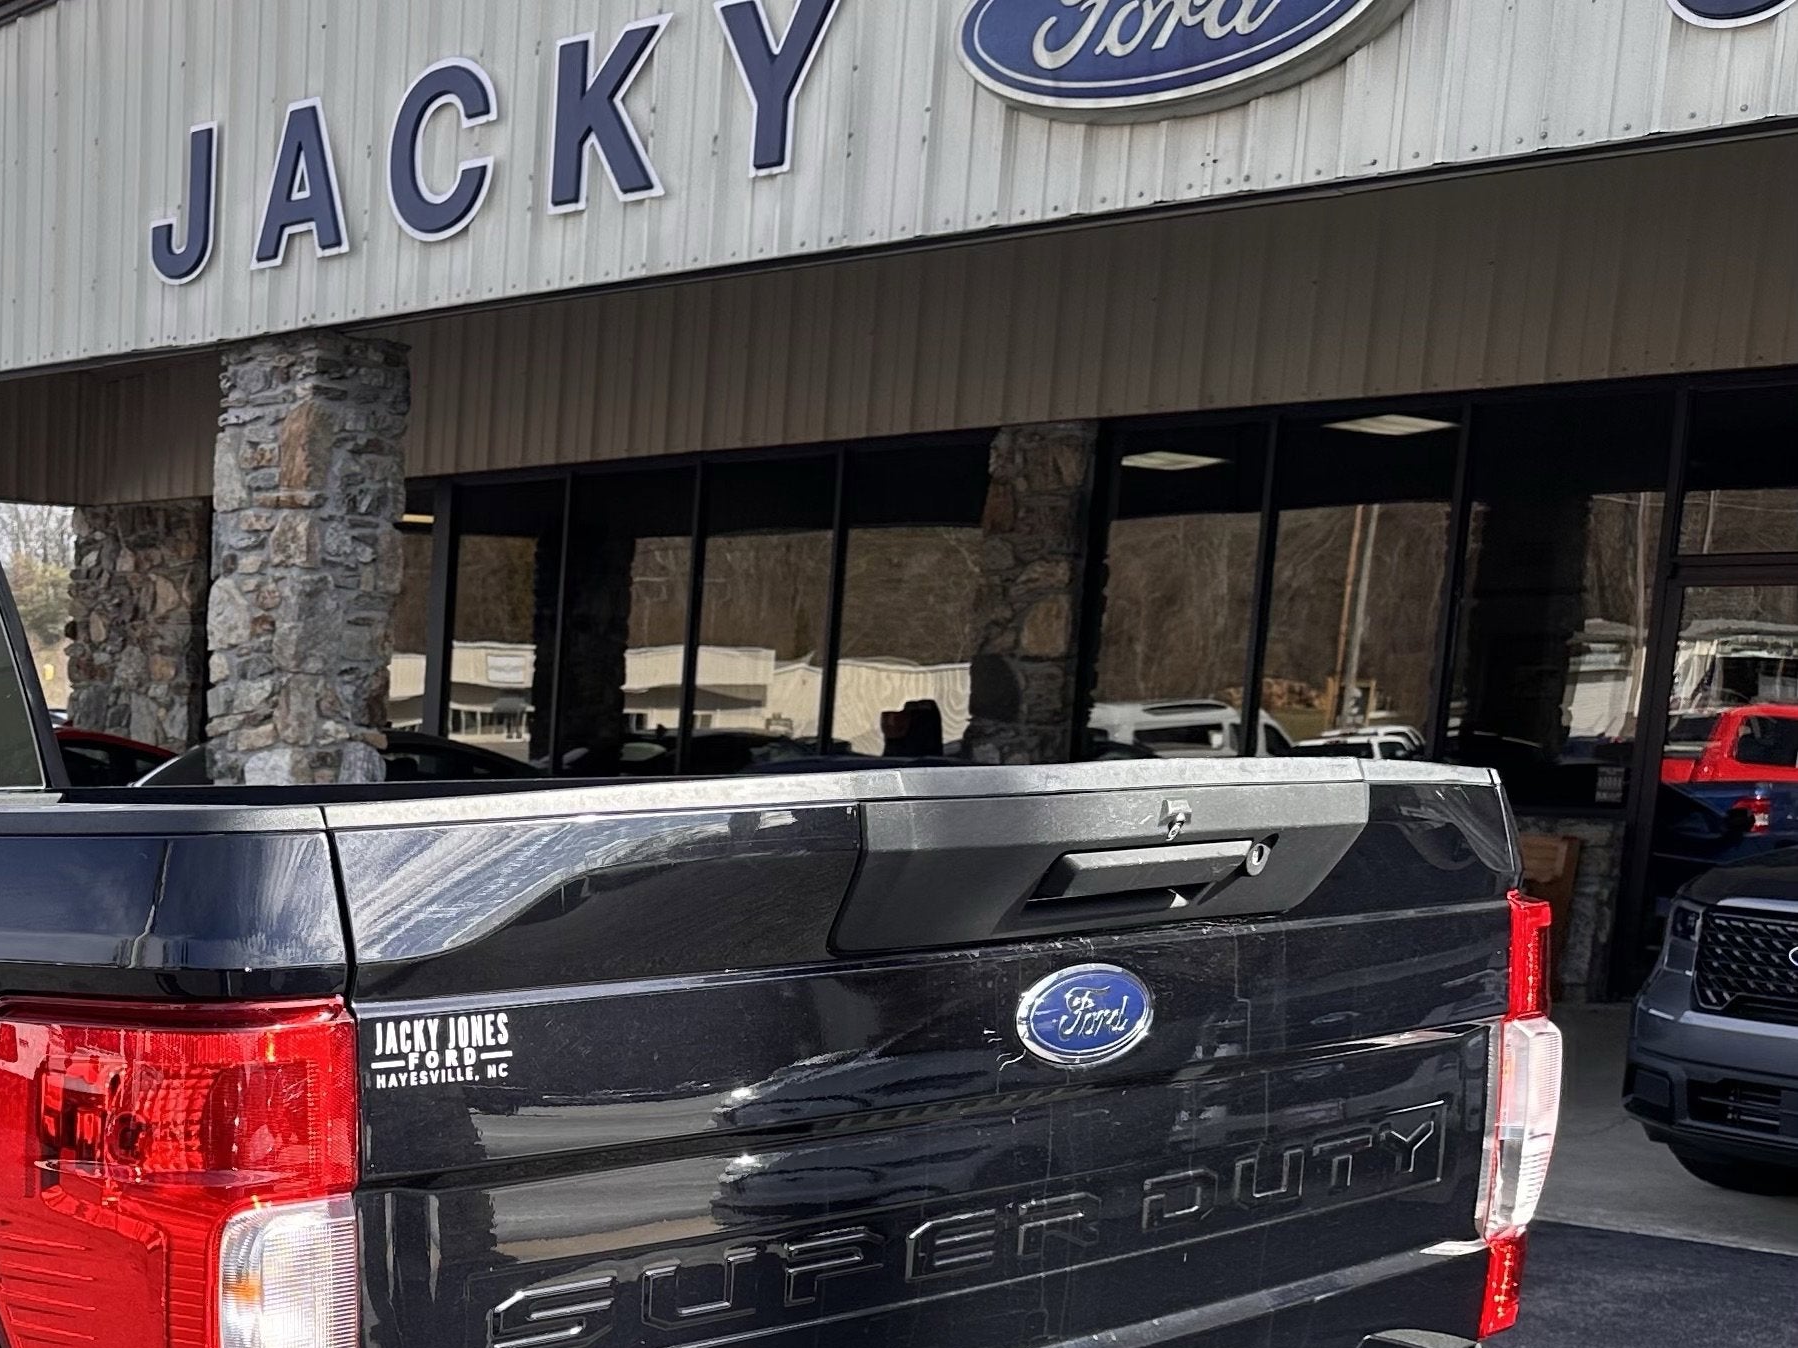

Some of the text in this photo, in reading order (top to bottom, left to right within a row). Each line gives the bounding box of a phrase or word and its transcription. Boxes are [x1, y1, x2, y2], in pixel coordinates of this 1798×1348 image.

[151, 0, 840, 286] JACKY
[374, 1012, 509, 1056] JACKY JONES
[1058, 985, 1129, 1042] Ford
[375, 1062, 509, 1089] HAYESVILLE, NC
[407, 1047, 477, 1071] FORD
[1142, 1120, 1435, 1232] DUTY
